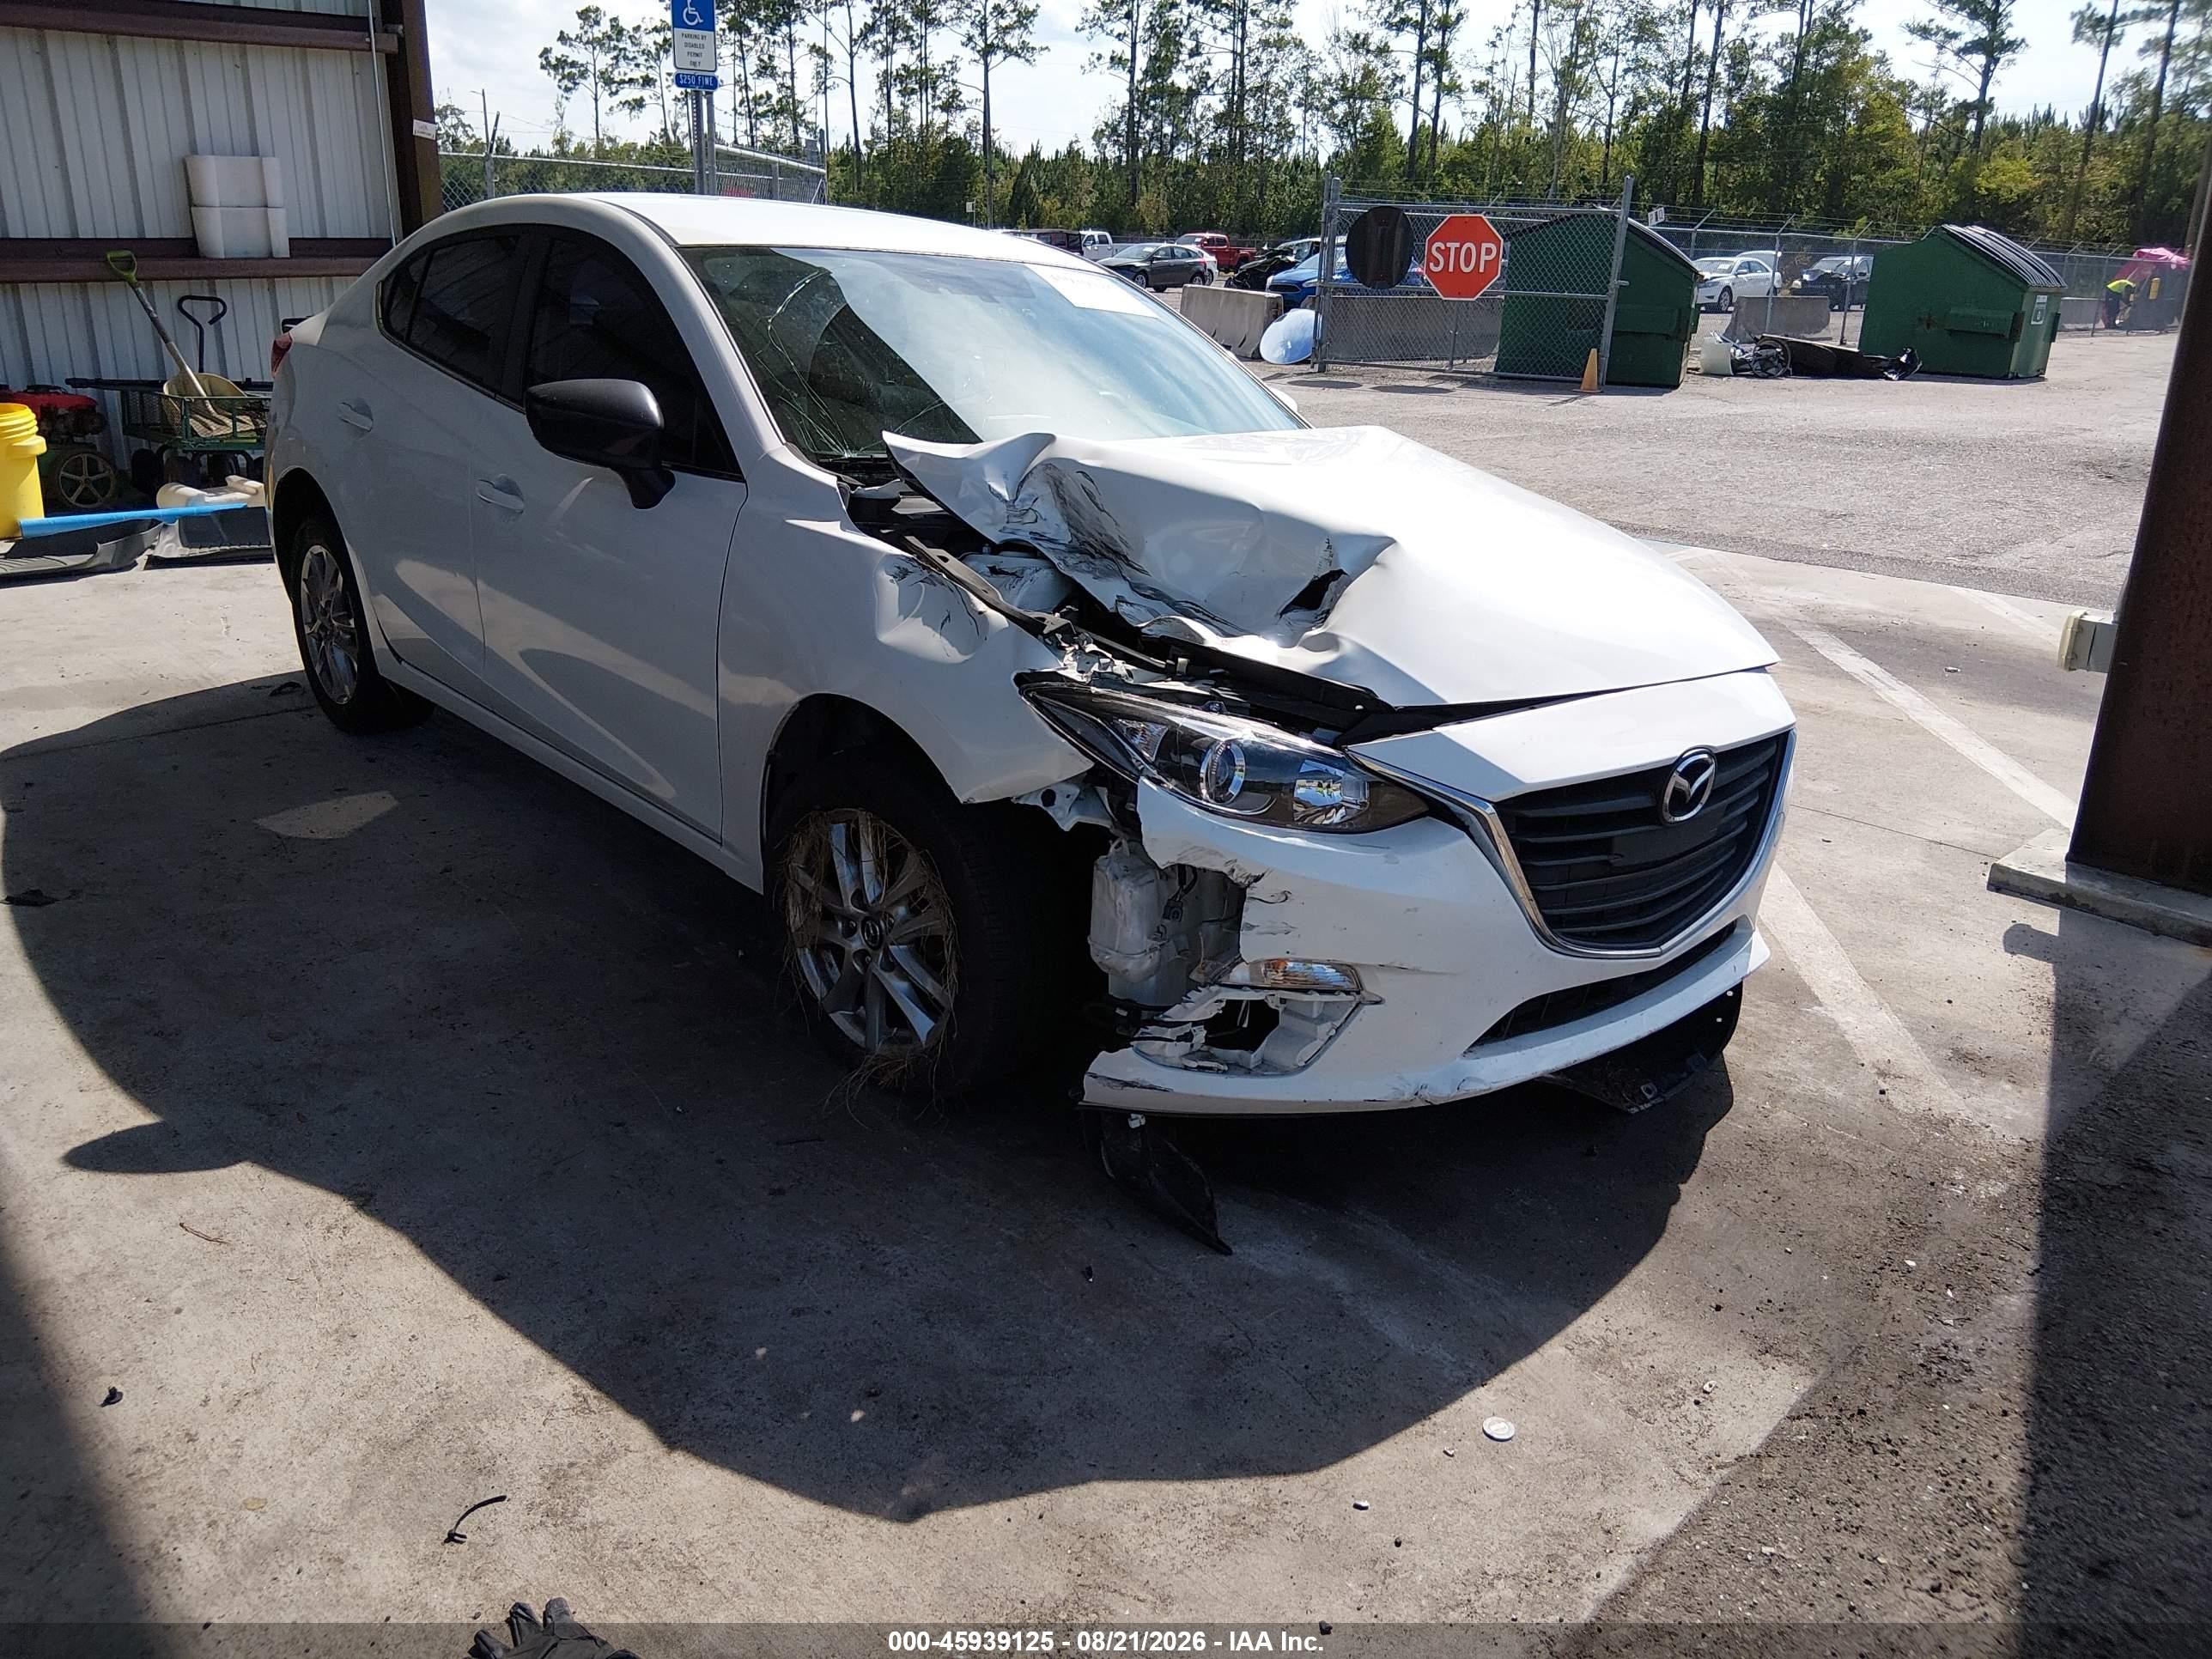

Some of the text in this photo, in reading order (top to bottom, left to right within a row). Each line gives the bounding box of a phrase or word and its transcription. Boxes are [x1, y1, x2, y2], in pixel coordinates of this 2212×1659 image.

[679, 74, 714, 86] $250 FINE
[1429, 241, 1498, 273] STOP
